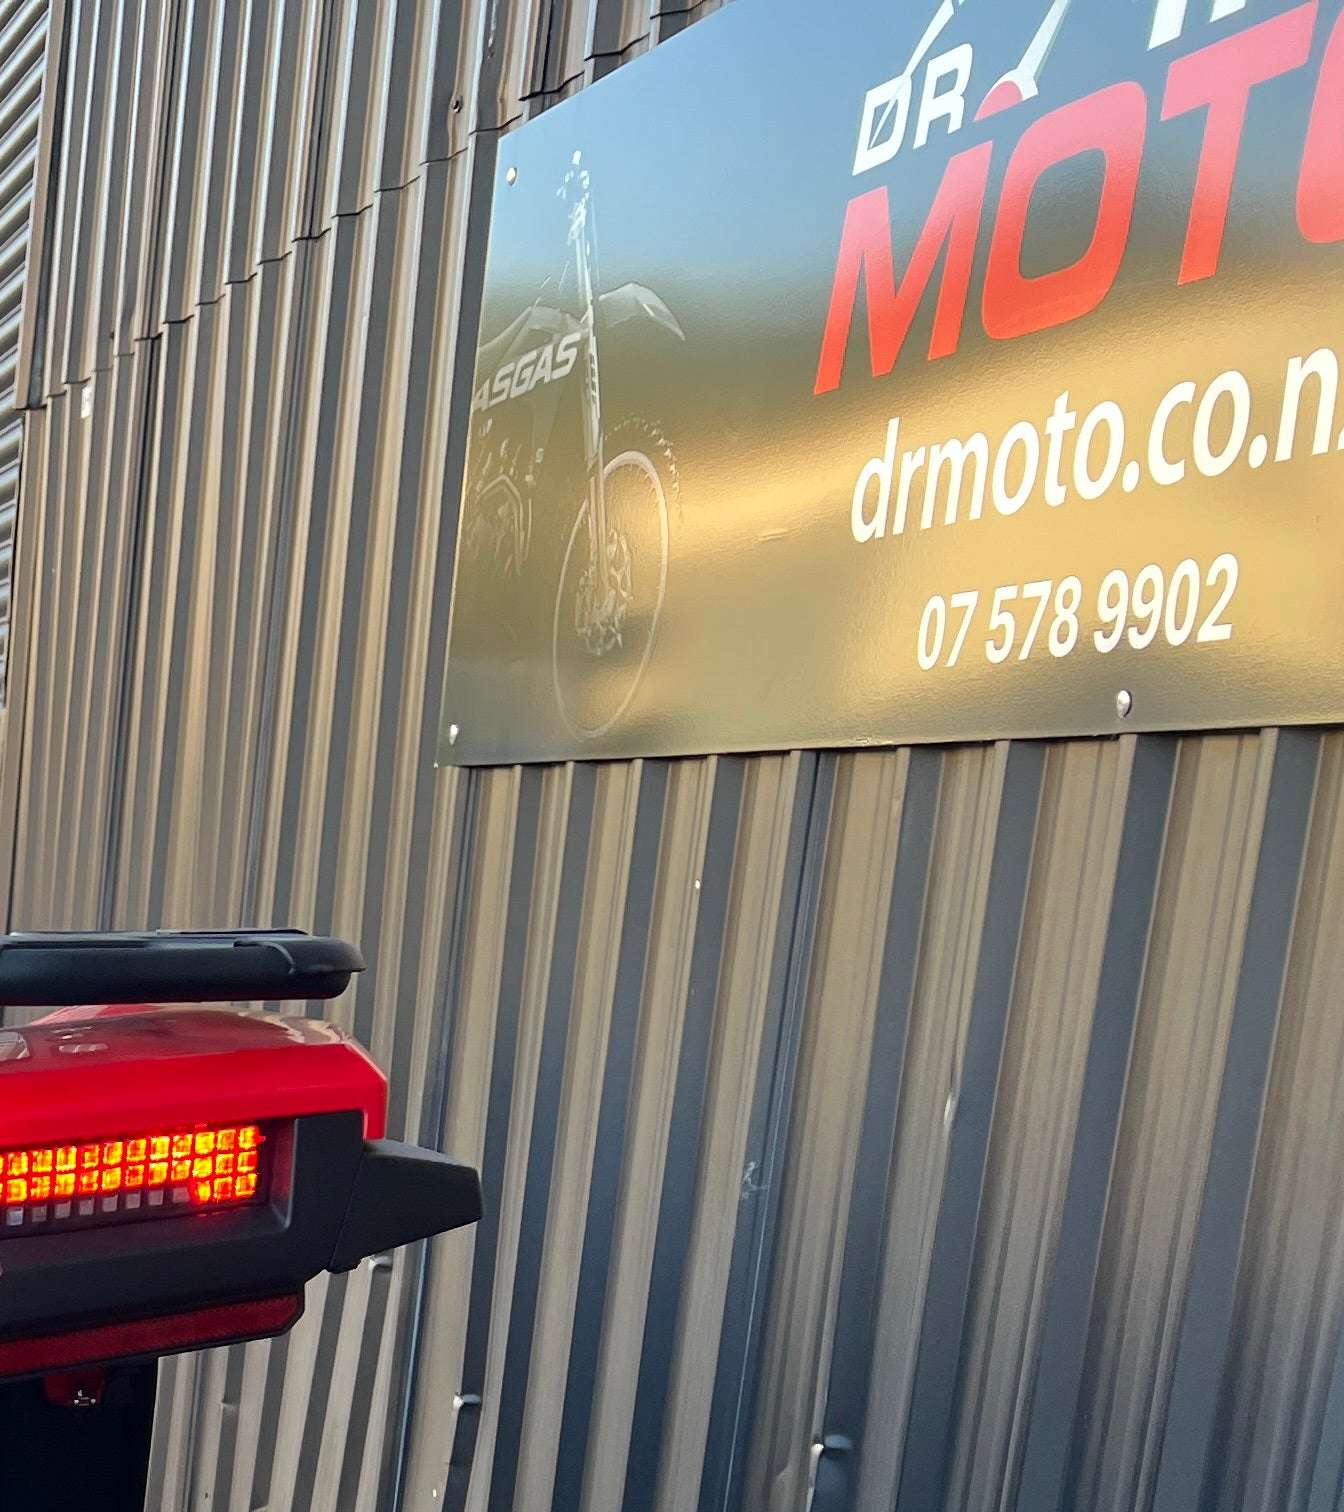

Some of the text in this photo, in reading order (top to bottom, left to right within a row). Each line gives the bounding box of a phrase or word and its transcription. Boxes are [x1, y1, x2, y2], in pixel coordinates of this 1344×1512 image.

[852, 43, 973, 176] DR
[812, 0, 1344, 396] MOT
[851, 348, 1344, 543] drmoto.co.n
[916, 553, 1240, 671] 07 578 9902
